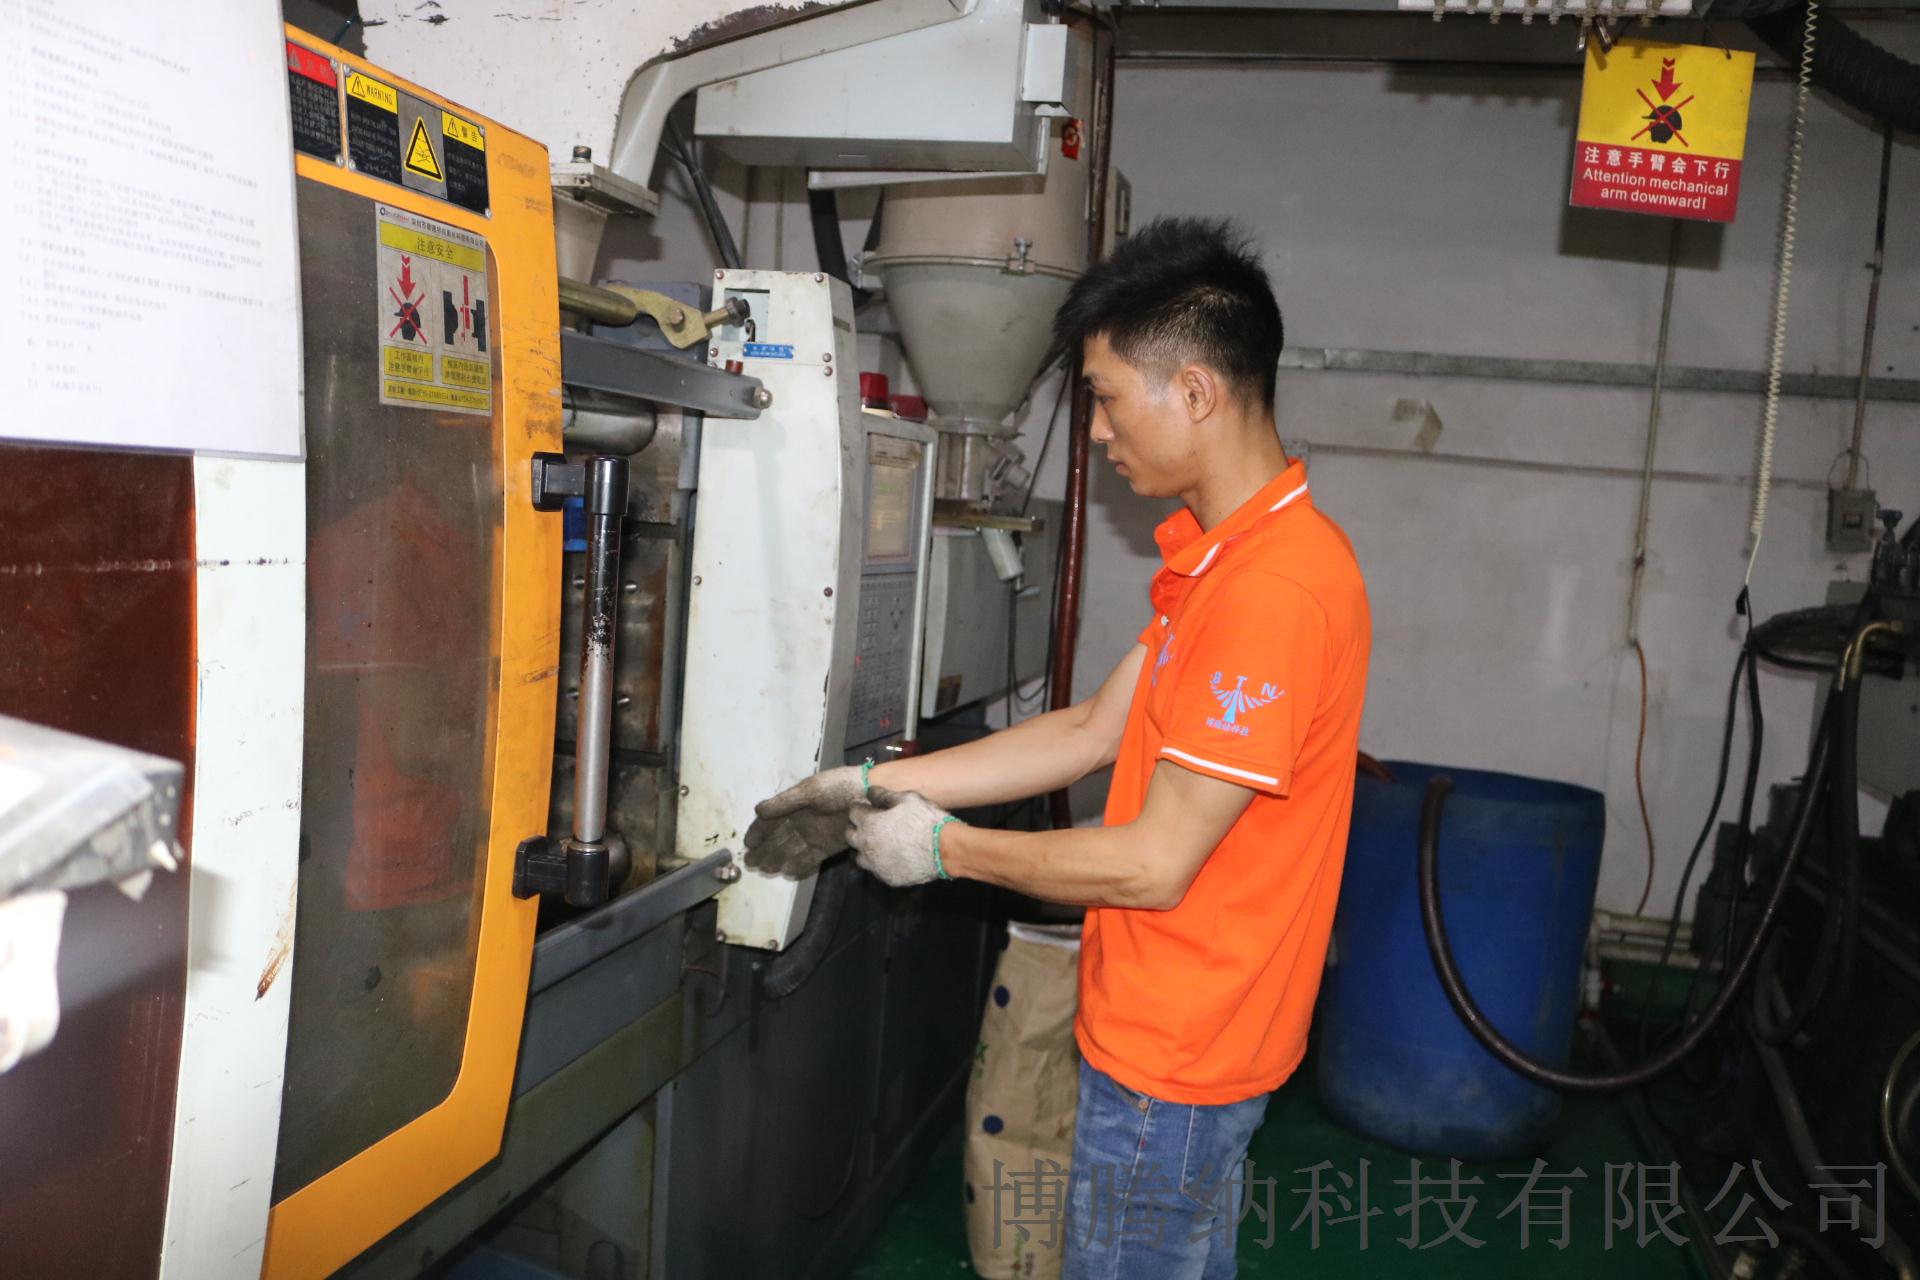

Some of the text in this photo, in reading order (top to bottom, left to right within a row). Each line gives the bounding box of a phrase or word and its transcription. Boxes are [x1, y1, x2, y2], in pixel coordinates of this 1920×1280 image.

[366, 83, 393, 105] WARNING
[1584, 146, 1730, 179] 注意手臂会下行
[1583, 167, 1728, 196] Attention mechanical
[1600, 187, 1627, 201] arm
[416, 237, 454, 260] 注意安全
